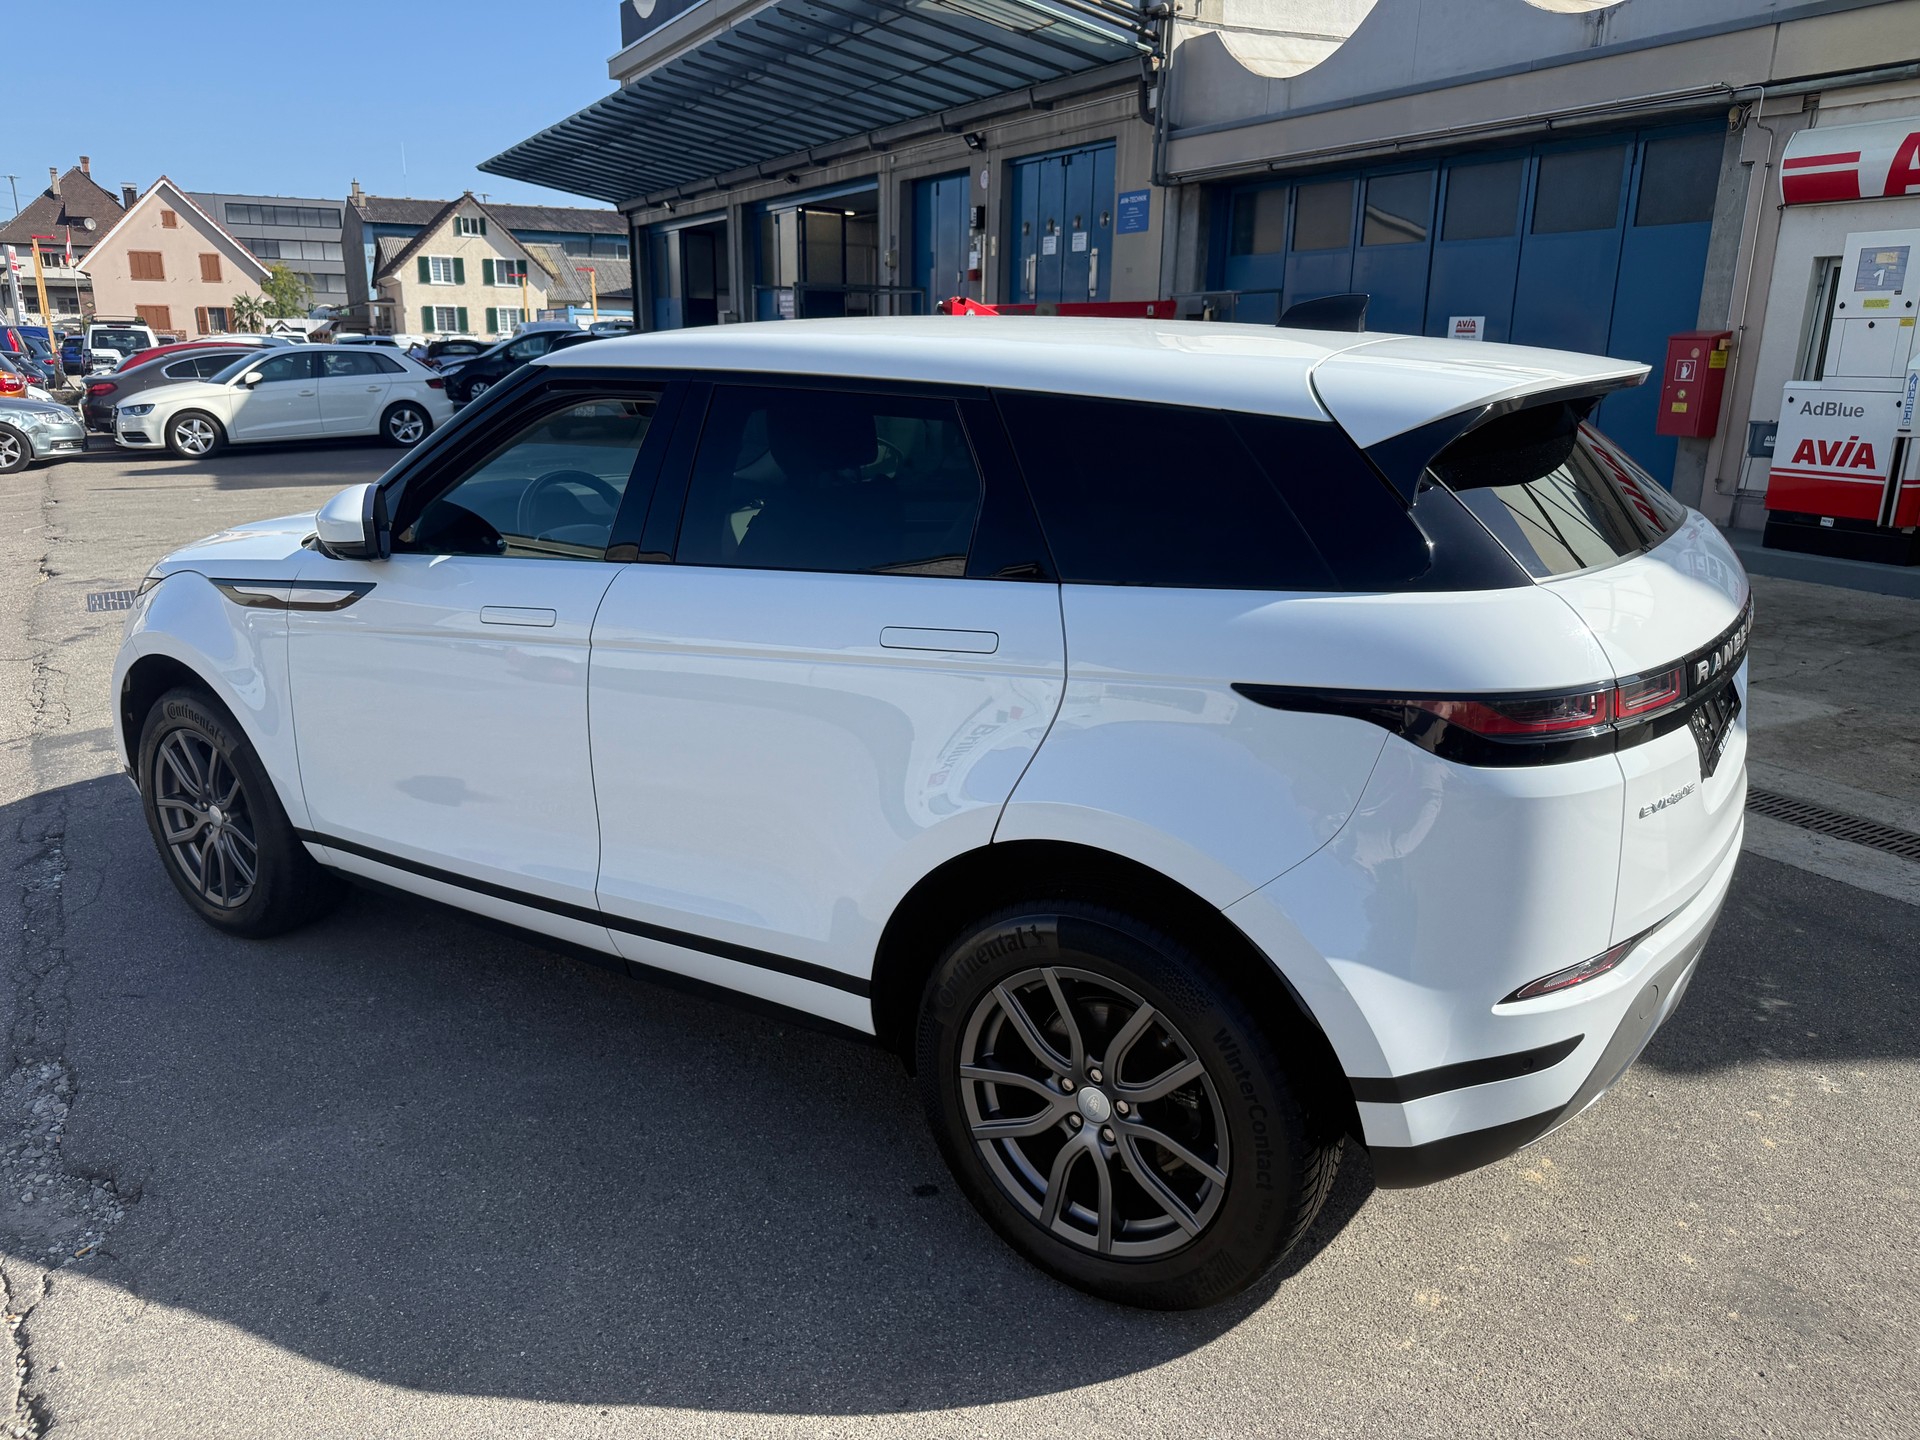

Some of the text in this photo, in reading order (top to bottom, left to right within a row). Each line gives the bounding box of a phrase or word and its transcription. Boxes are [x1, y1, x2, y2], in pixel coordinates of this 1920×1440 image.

[1873, 269, 1886, 286] 1
[1800, 401, 1865, 418] AdBlue
[167, 702, 220, 740] Continental
[938, 927, 1028, 1008] Continental
[1212, 1027, 1274, 1191] WinterContact
